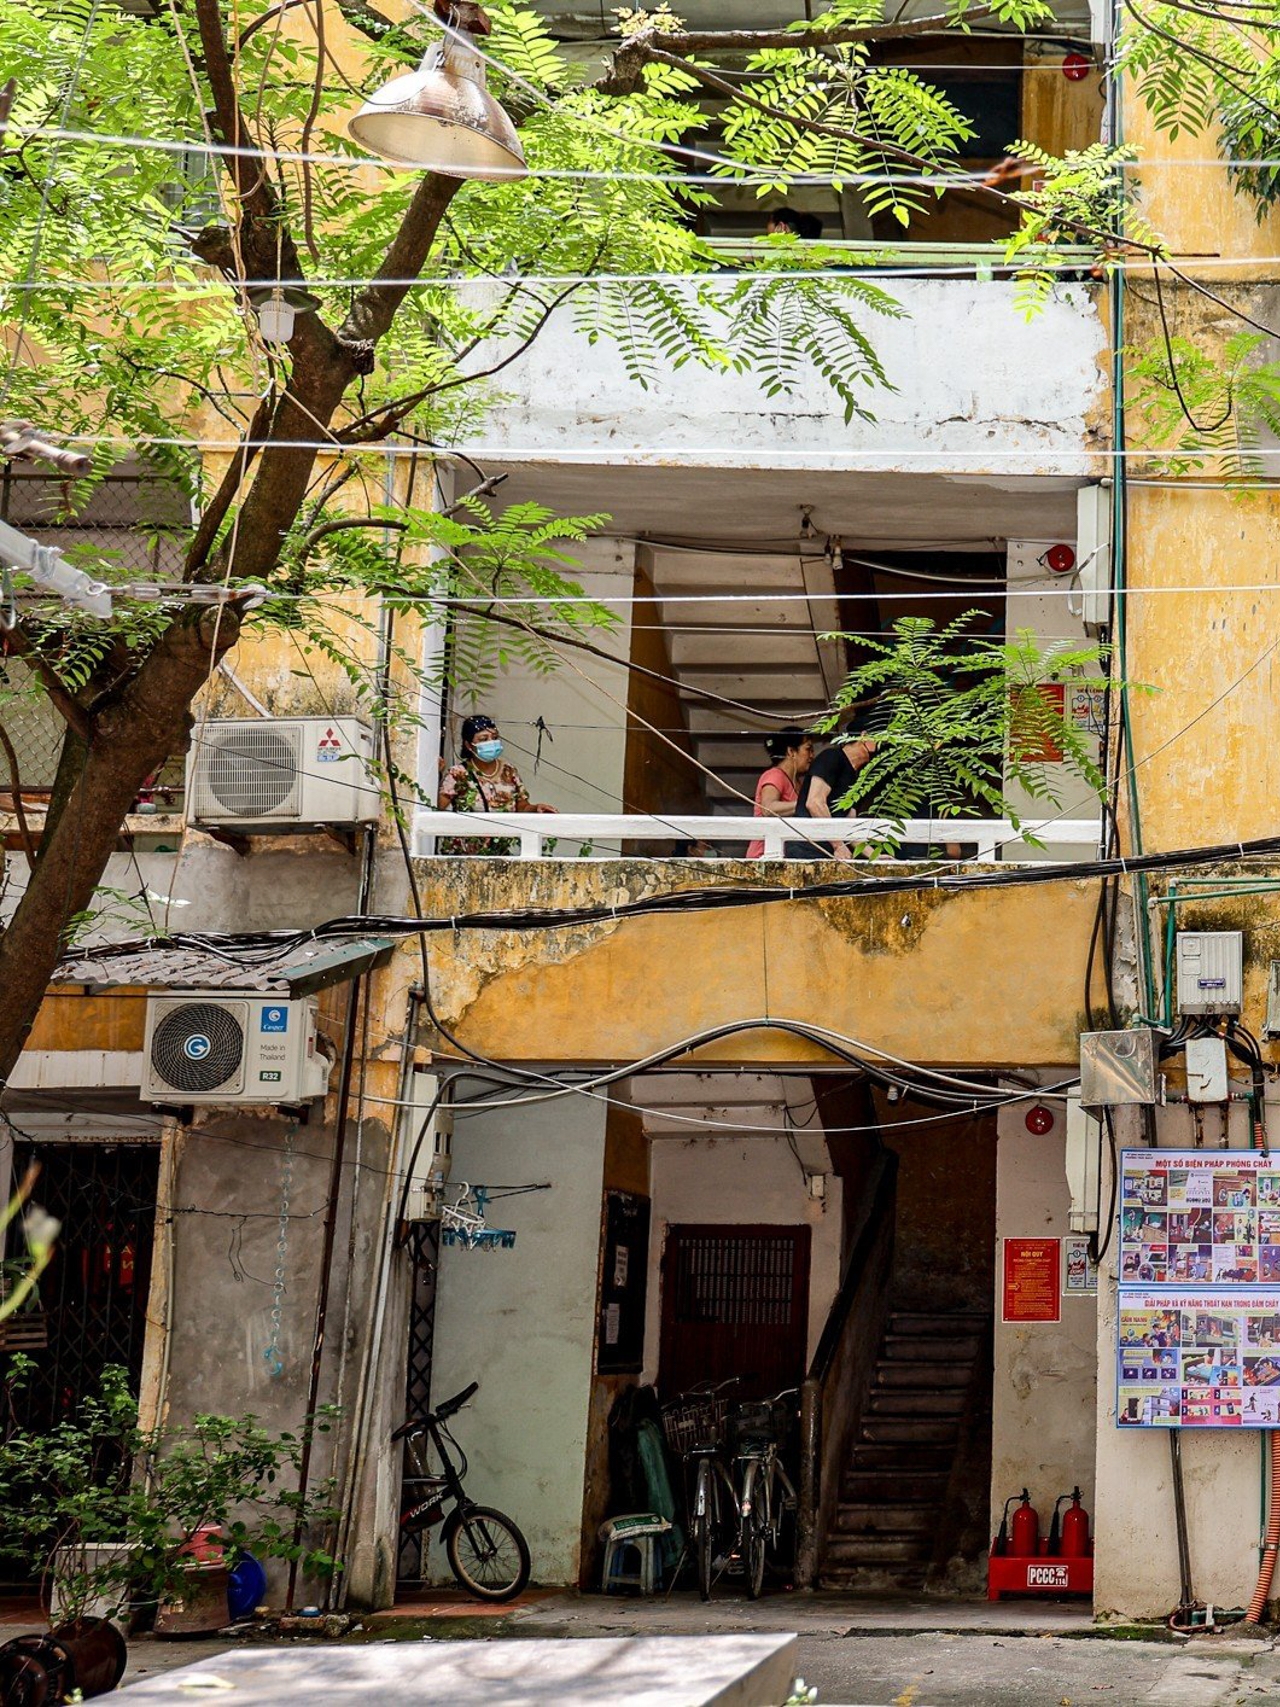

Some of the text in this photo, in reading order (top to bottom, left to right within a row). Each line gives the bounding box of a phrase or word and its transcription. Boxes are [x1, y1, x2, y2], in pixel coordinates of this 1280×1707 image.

[259, 1053, 286, 1061] Thailand
[262, 1072, 279, 1080] R32
[1155, 1159, 1171, 1168] MỘT
[1173, 1157, 1183, 1168] SỐ
[1185, 1158, 1202, 1168] BIỆN
[1204, 1159, 1225, 1168] PHÁP
[1253, 1159, 1273, 1168] CHÁY
[1030, 1567, 1055, 1584] PCCC
